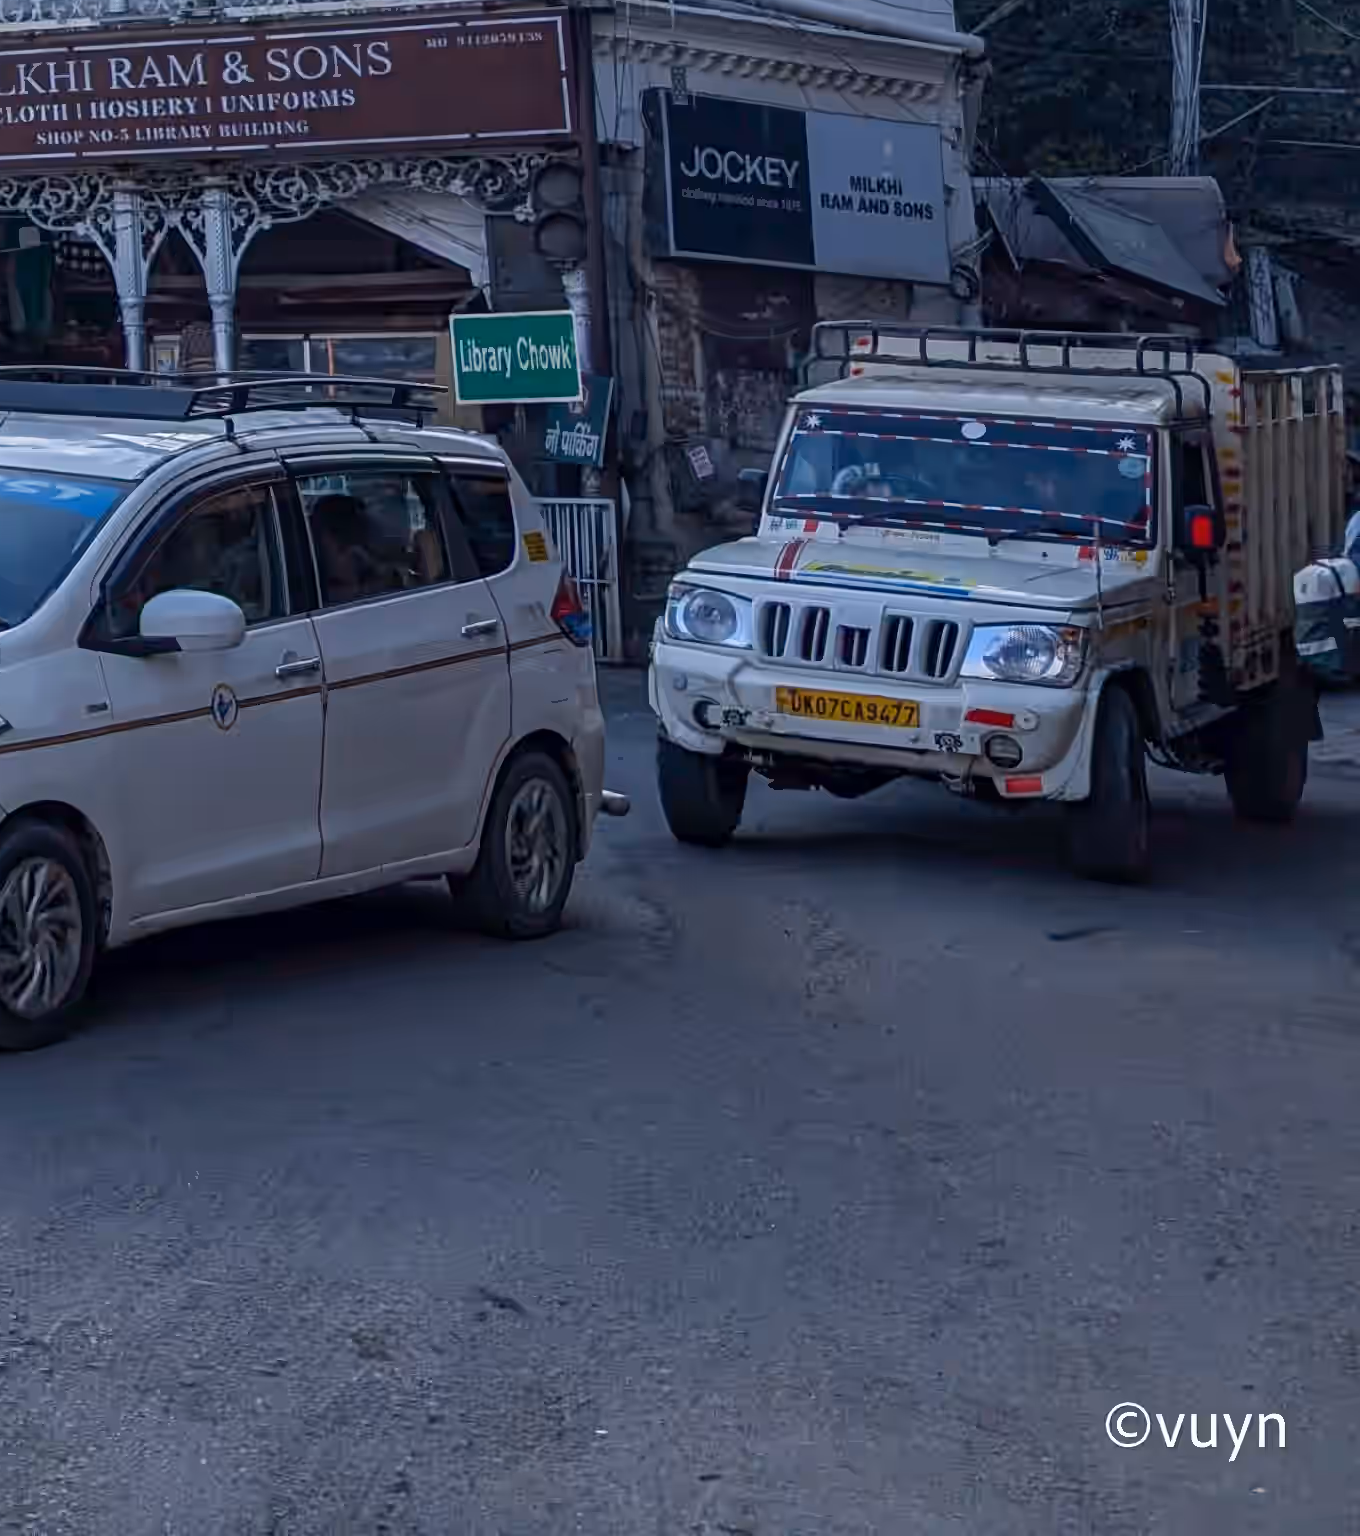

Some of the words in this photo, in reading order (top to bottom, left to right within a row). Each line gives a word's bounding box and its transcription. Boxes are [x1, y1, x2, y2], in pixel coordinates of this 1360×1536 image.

[108, 53, 208, 90] RAM
[222, 50, 255, 84] &
[266, 41, 393, 82] SONS
[90, 96, 198, 120] HOSIERY
[221, 88, 356, 114] UNIFORMS
[36, 129, 84, 145] SHOP
[135, 124, 212, 142] LIBRARY
[219, 120, 309, 139] BUILDING
[680, 144, 800, 189] JOCKEY
[849, 175, 903, 196] MILKHI
[821, 194, 854, 211] RAM
[857, 195, 889, 215] AND
[894, 199, 933, 221] SONS
[459, 338, 511, 378] Library
[517, 336, 573, 370] Chowk
[545, 420, 560, 456] नो
[791, 691, 915, 725] UK07CA9477
